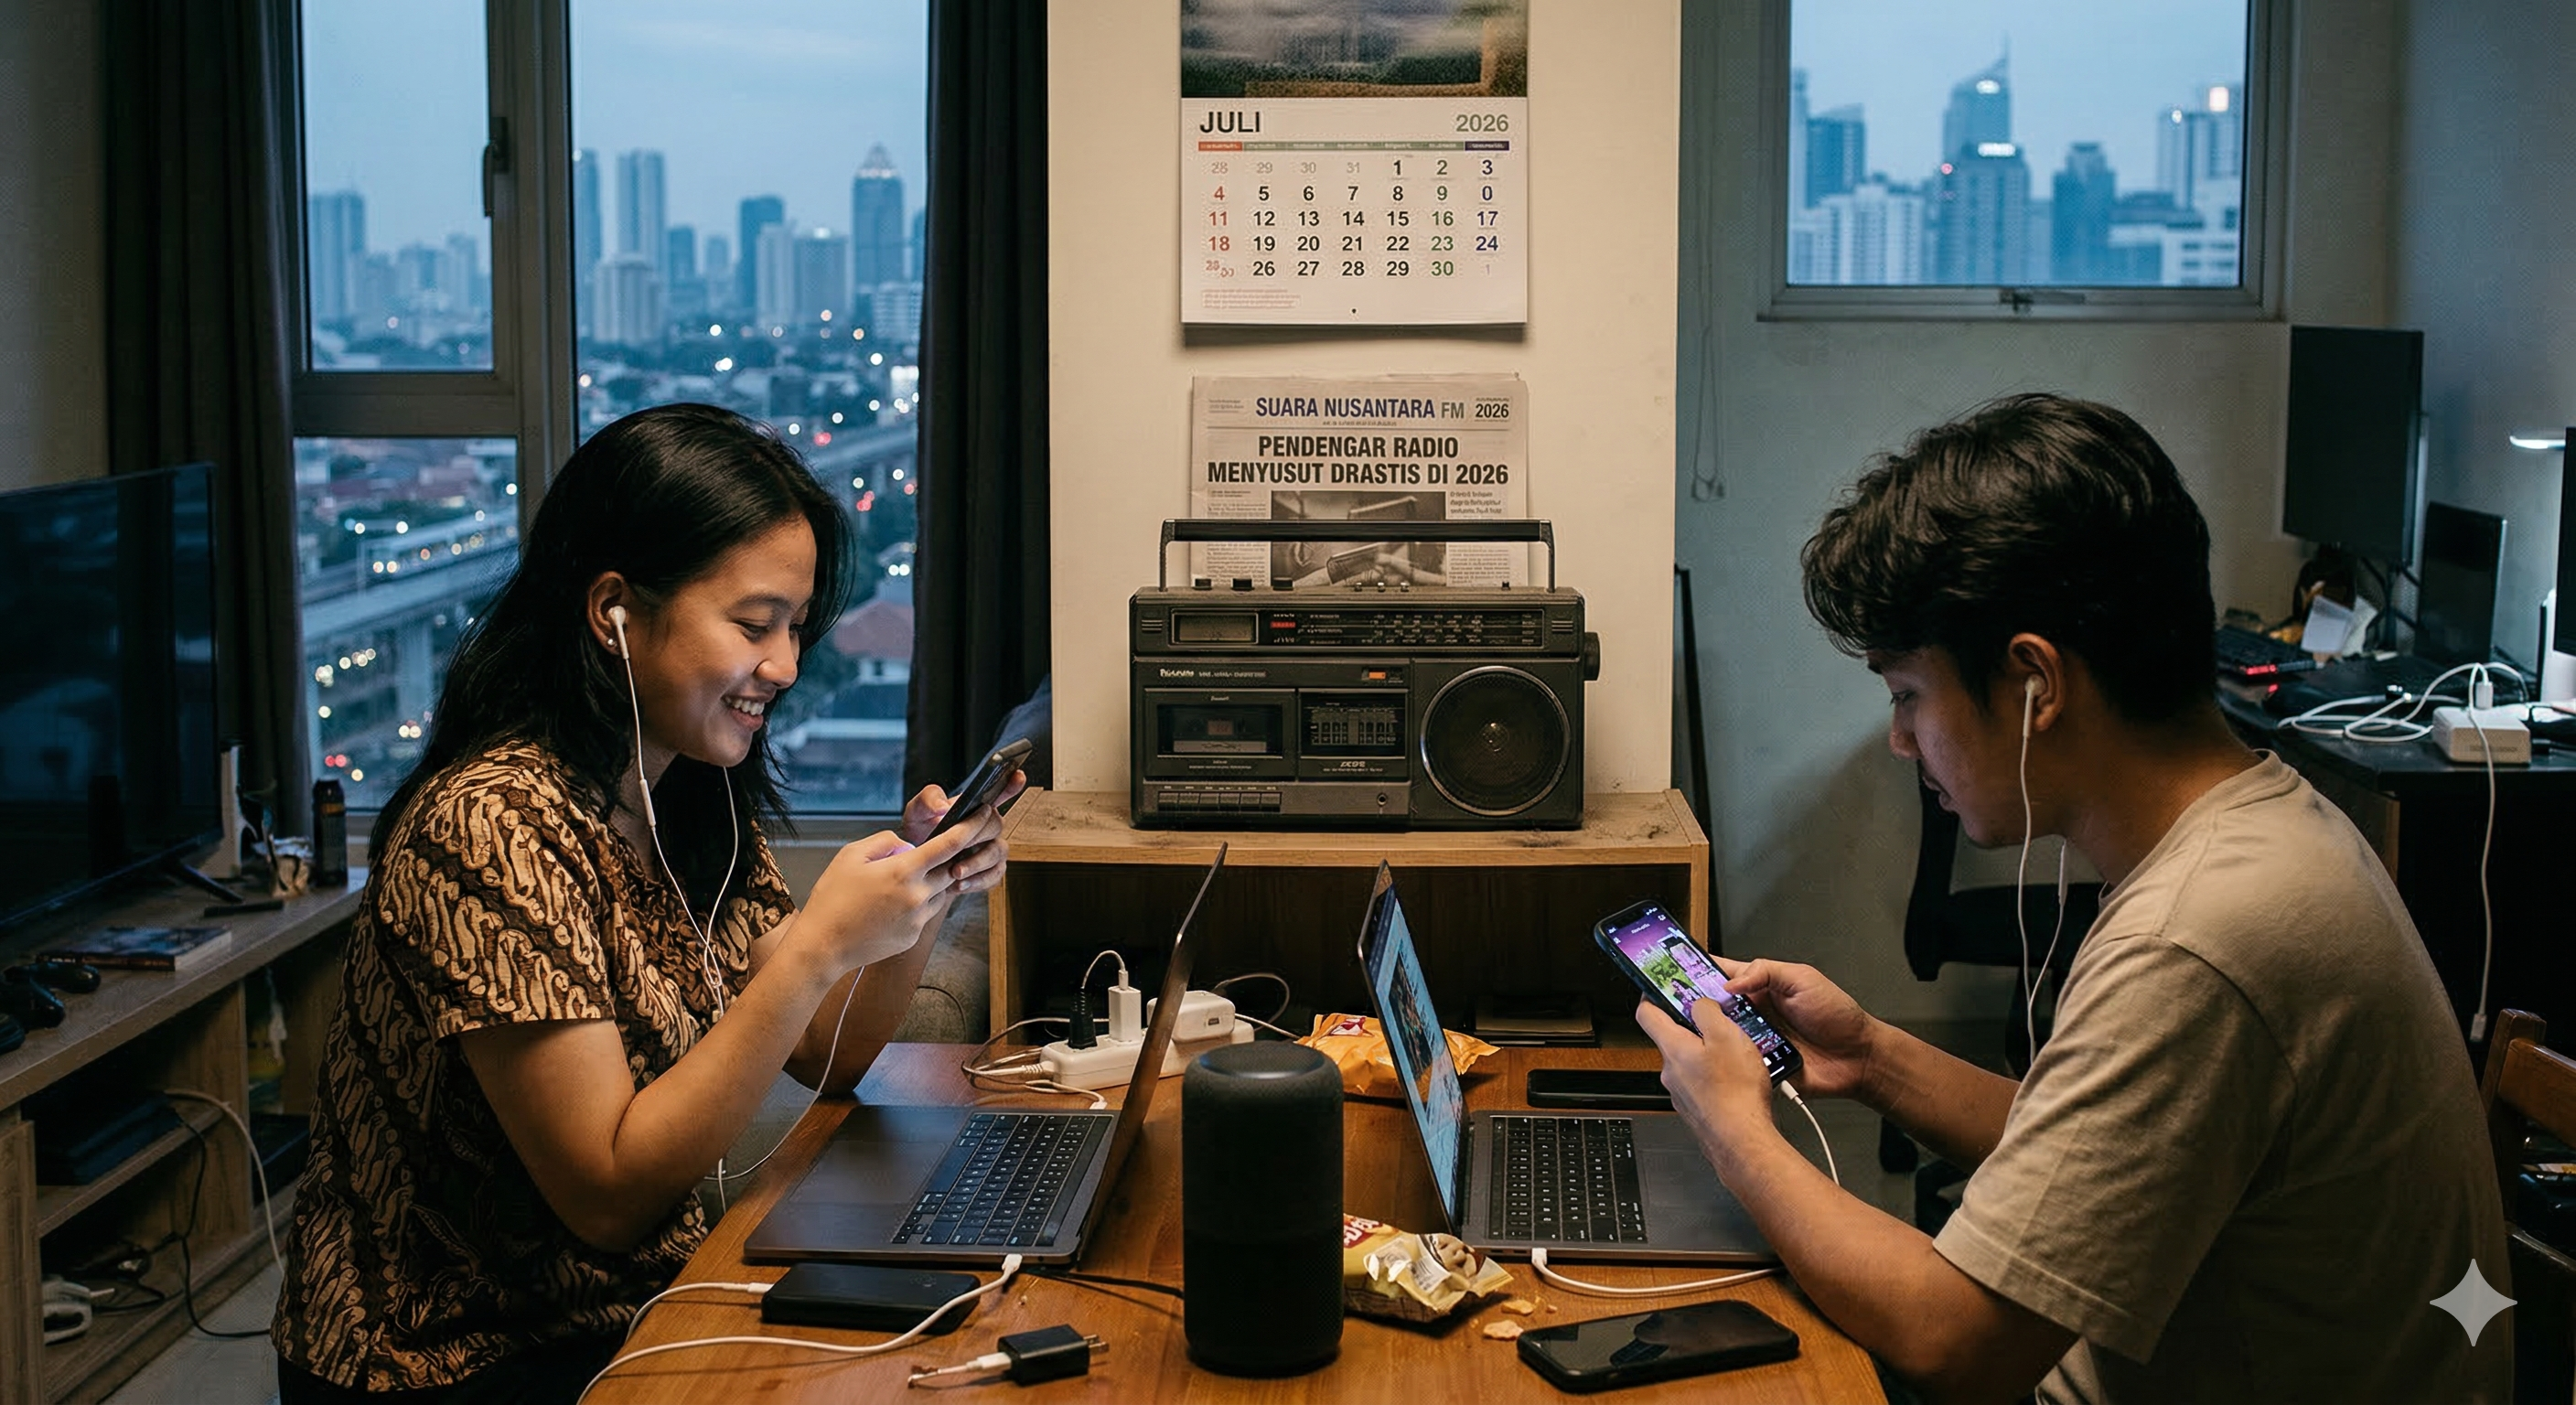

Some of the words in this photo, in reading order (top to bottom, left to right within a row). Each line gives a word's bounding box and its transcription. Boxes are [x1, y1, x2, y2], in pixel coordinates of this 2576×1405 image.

[1200, 112, 1260, 133] JULI
[1456, 114, 1508, 132] 2026
[1256, 161, 1273, 175] 29
[1300, 161, 1317, 174] 30
[1346, 161, 1360, 174] 31
[1393, 159, 1401, 176] 1
[1436, 159, 1448, 176] 2
[1482, 159, 1493, 176] 3
[1213, 186, 1226, 201] 4
[1259, 186, 1270, 201] 5
[1303, 185, 1315, 201] 6
[1347, 186, 1358, 201] 7
[1392, 185, 1404, 201] 8
[1436, 185, 1448, 201] 9
[1482, 185, 1493, 201] 0
[1208, 210, 1229, 226] 11
[1253, 210, 1275, 227] 12
[1298, 210, 1320, 227] 13
[1342, 210, 1365, 226] 14
[1387, 210, 1410, 227] 15
[1432, 210, 1454, 227] 16
[1476, 210, 1498, 226] 17
[1208, 235, 1230, 252] 18
[1253, 235, 1276, 252] 19
[1297, 235, 1320, 252] 20
[1342, 235, 1362, 252] 21
[1386, 235, 1410, 252] 22
[1431, 235, 1454, 252] 23
[1476, 235, 1498, 252] 24
[1252, 261, 1276, 277] 26
[1297, 261, 1320, 276] 27
[1342, 261, 1365, 276] 28
[1386, 261, 1410, 276] 29
[1431, 261, 1454, 276] 30
[1256, 398, 1318, 416] SUARA
[1326, 399, 1434, 418] NUSANTARA
[1442, 402, 1464, 418] FM
[1476, 404, 1508, 417] 2026
[1260, 436, 1385, 457] PENDENGAR
[1394, 437, 1457, 457] RADIO
[1208, 463, 1324, 483] MENYUSUT
[1332, 464, 1420, 484] DRASTIS
[1428, 465, 1447, 484] DI
[1456, 465, 1508, 484] 2026
